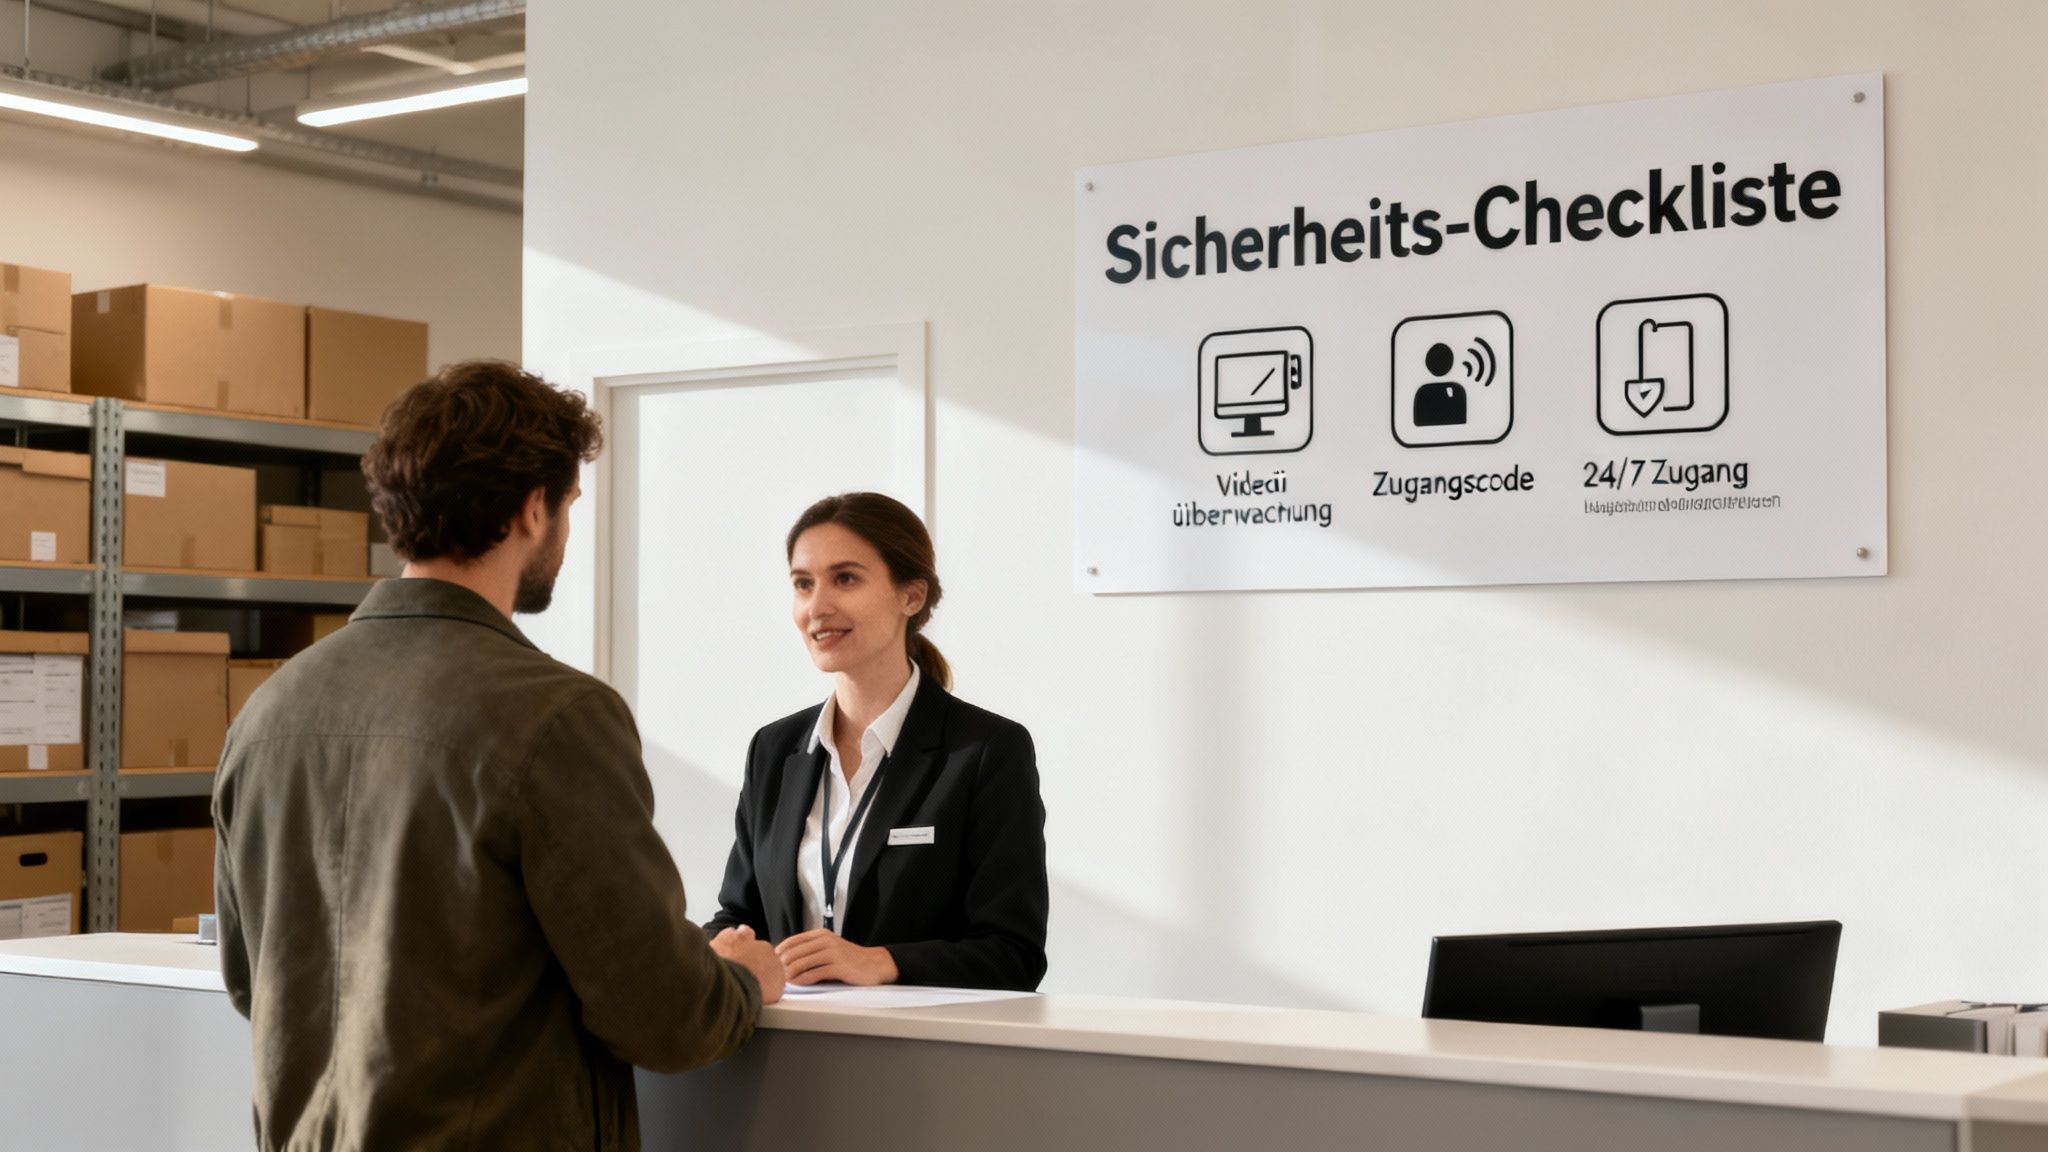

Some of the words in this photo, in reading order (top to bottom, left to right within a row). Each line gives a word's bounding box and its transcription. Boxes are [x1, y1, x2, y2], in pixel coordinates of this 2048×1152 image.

[1104, 161, 1842, 285] Sicherheits-Checkliste
[1372, 464, 1535, 502] Zugangscode
[1583, 457, 1646, 490] 24/7
[1650, 458, 1749, 492] Zugang
